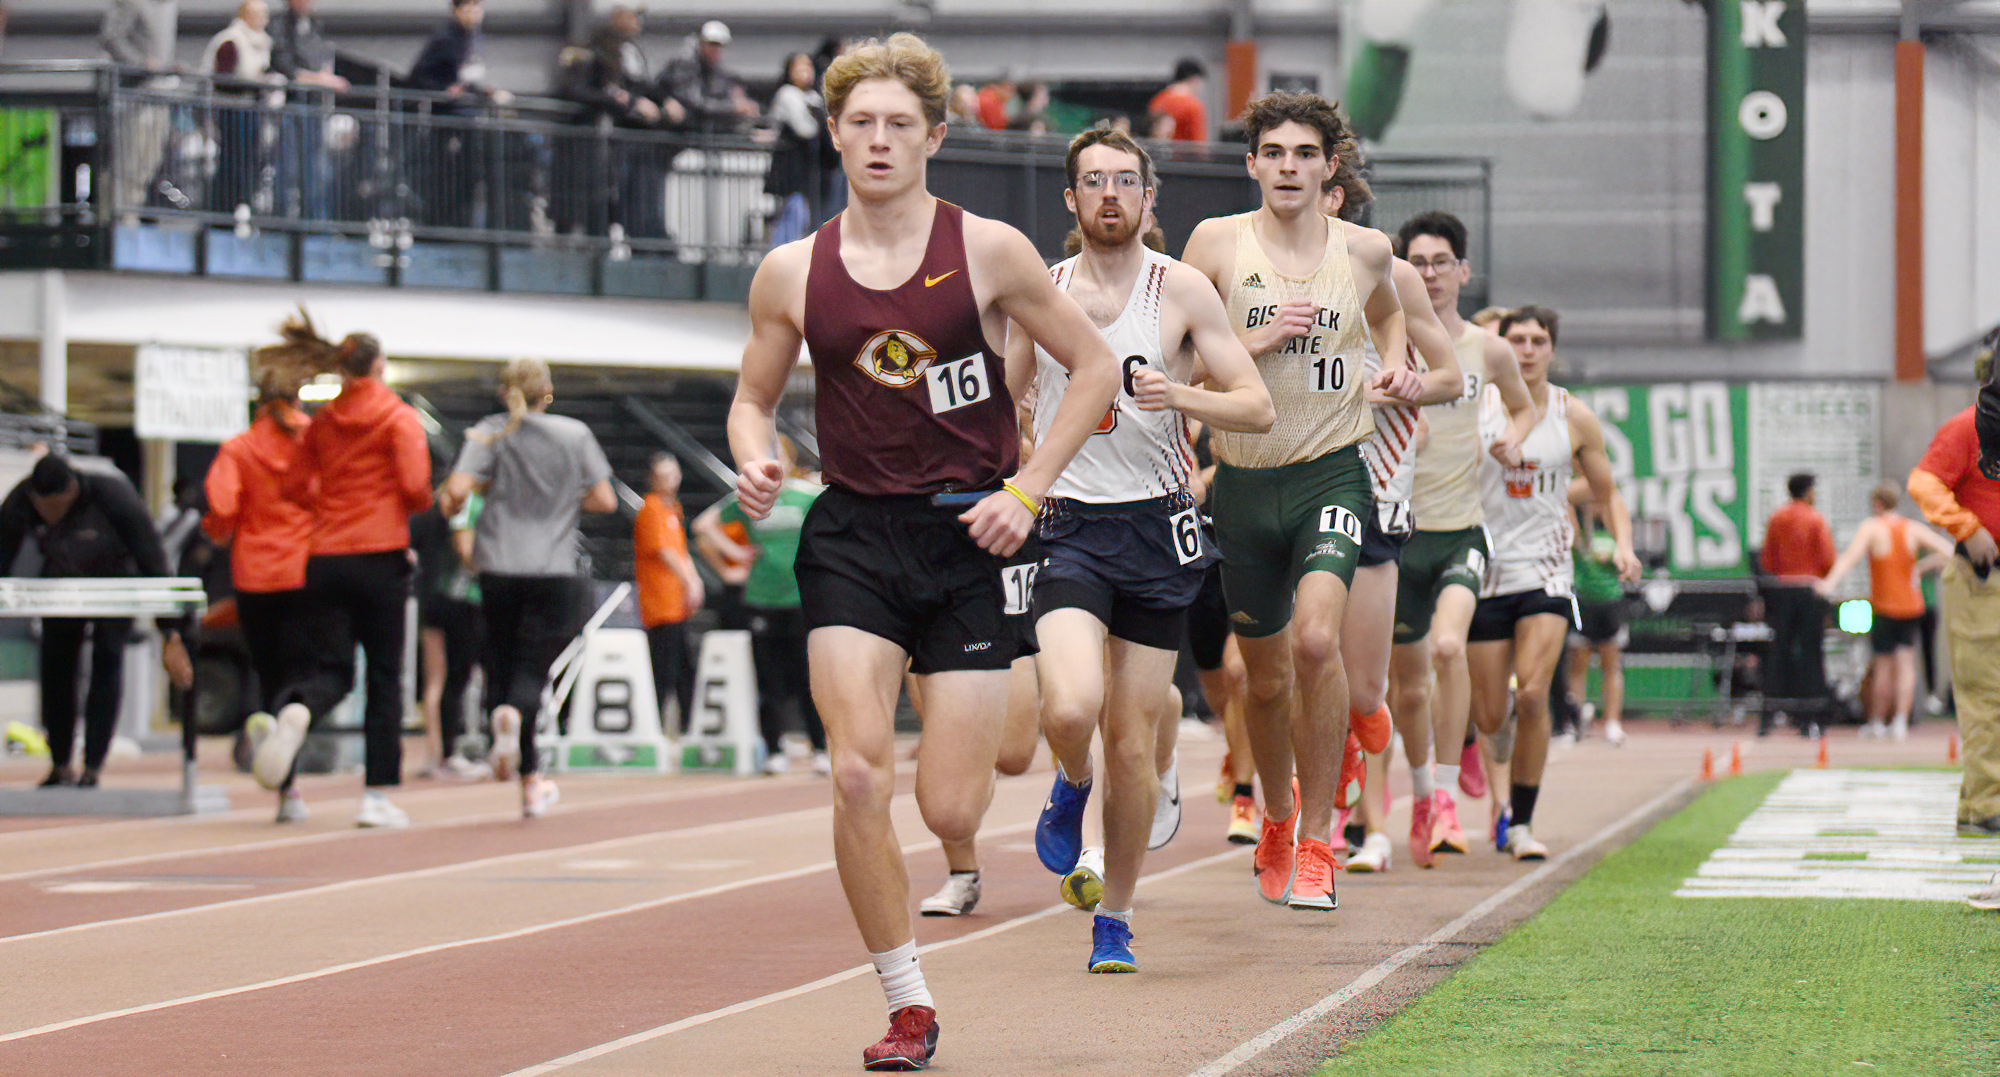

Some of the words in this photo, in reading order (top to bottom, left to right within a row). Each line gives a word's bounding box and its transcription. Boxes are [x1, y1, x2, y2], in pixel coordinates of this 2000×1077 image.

[1246, 304, 1341, 331] BISCK
[1278, 335, 1322, 354] ATE
[937, 359, 980, 407] 16
[1313, 356, 1344, 391] 10
[1650, 382, 1734, 475] GO
[1538, 472, 1557, 494] 11
[1176, 514, 1198, 558] 6
[1325, 507, 1355, 537] 10
[594, 677, 632, 734] 8
[701, 678, 727, 736] 5
